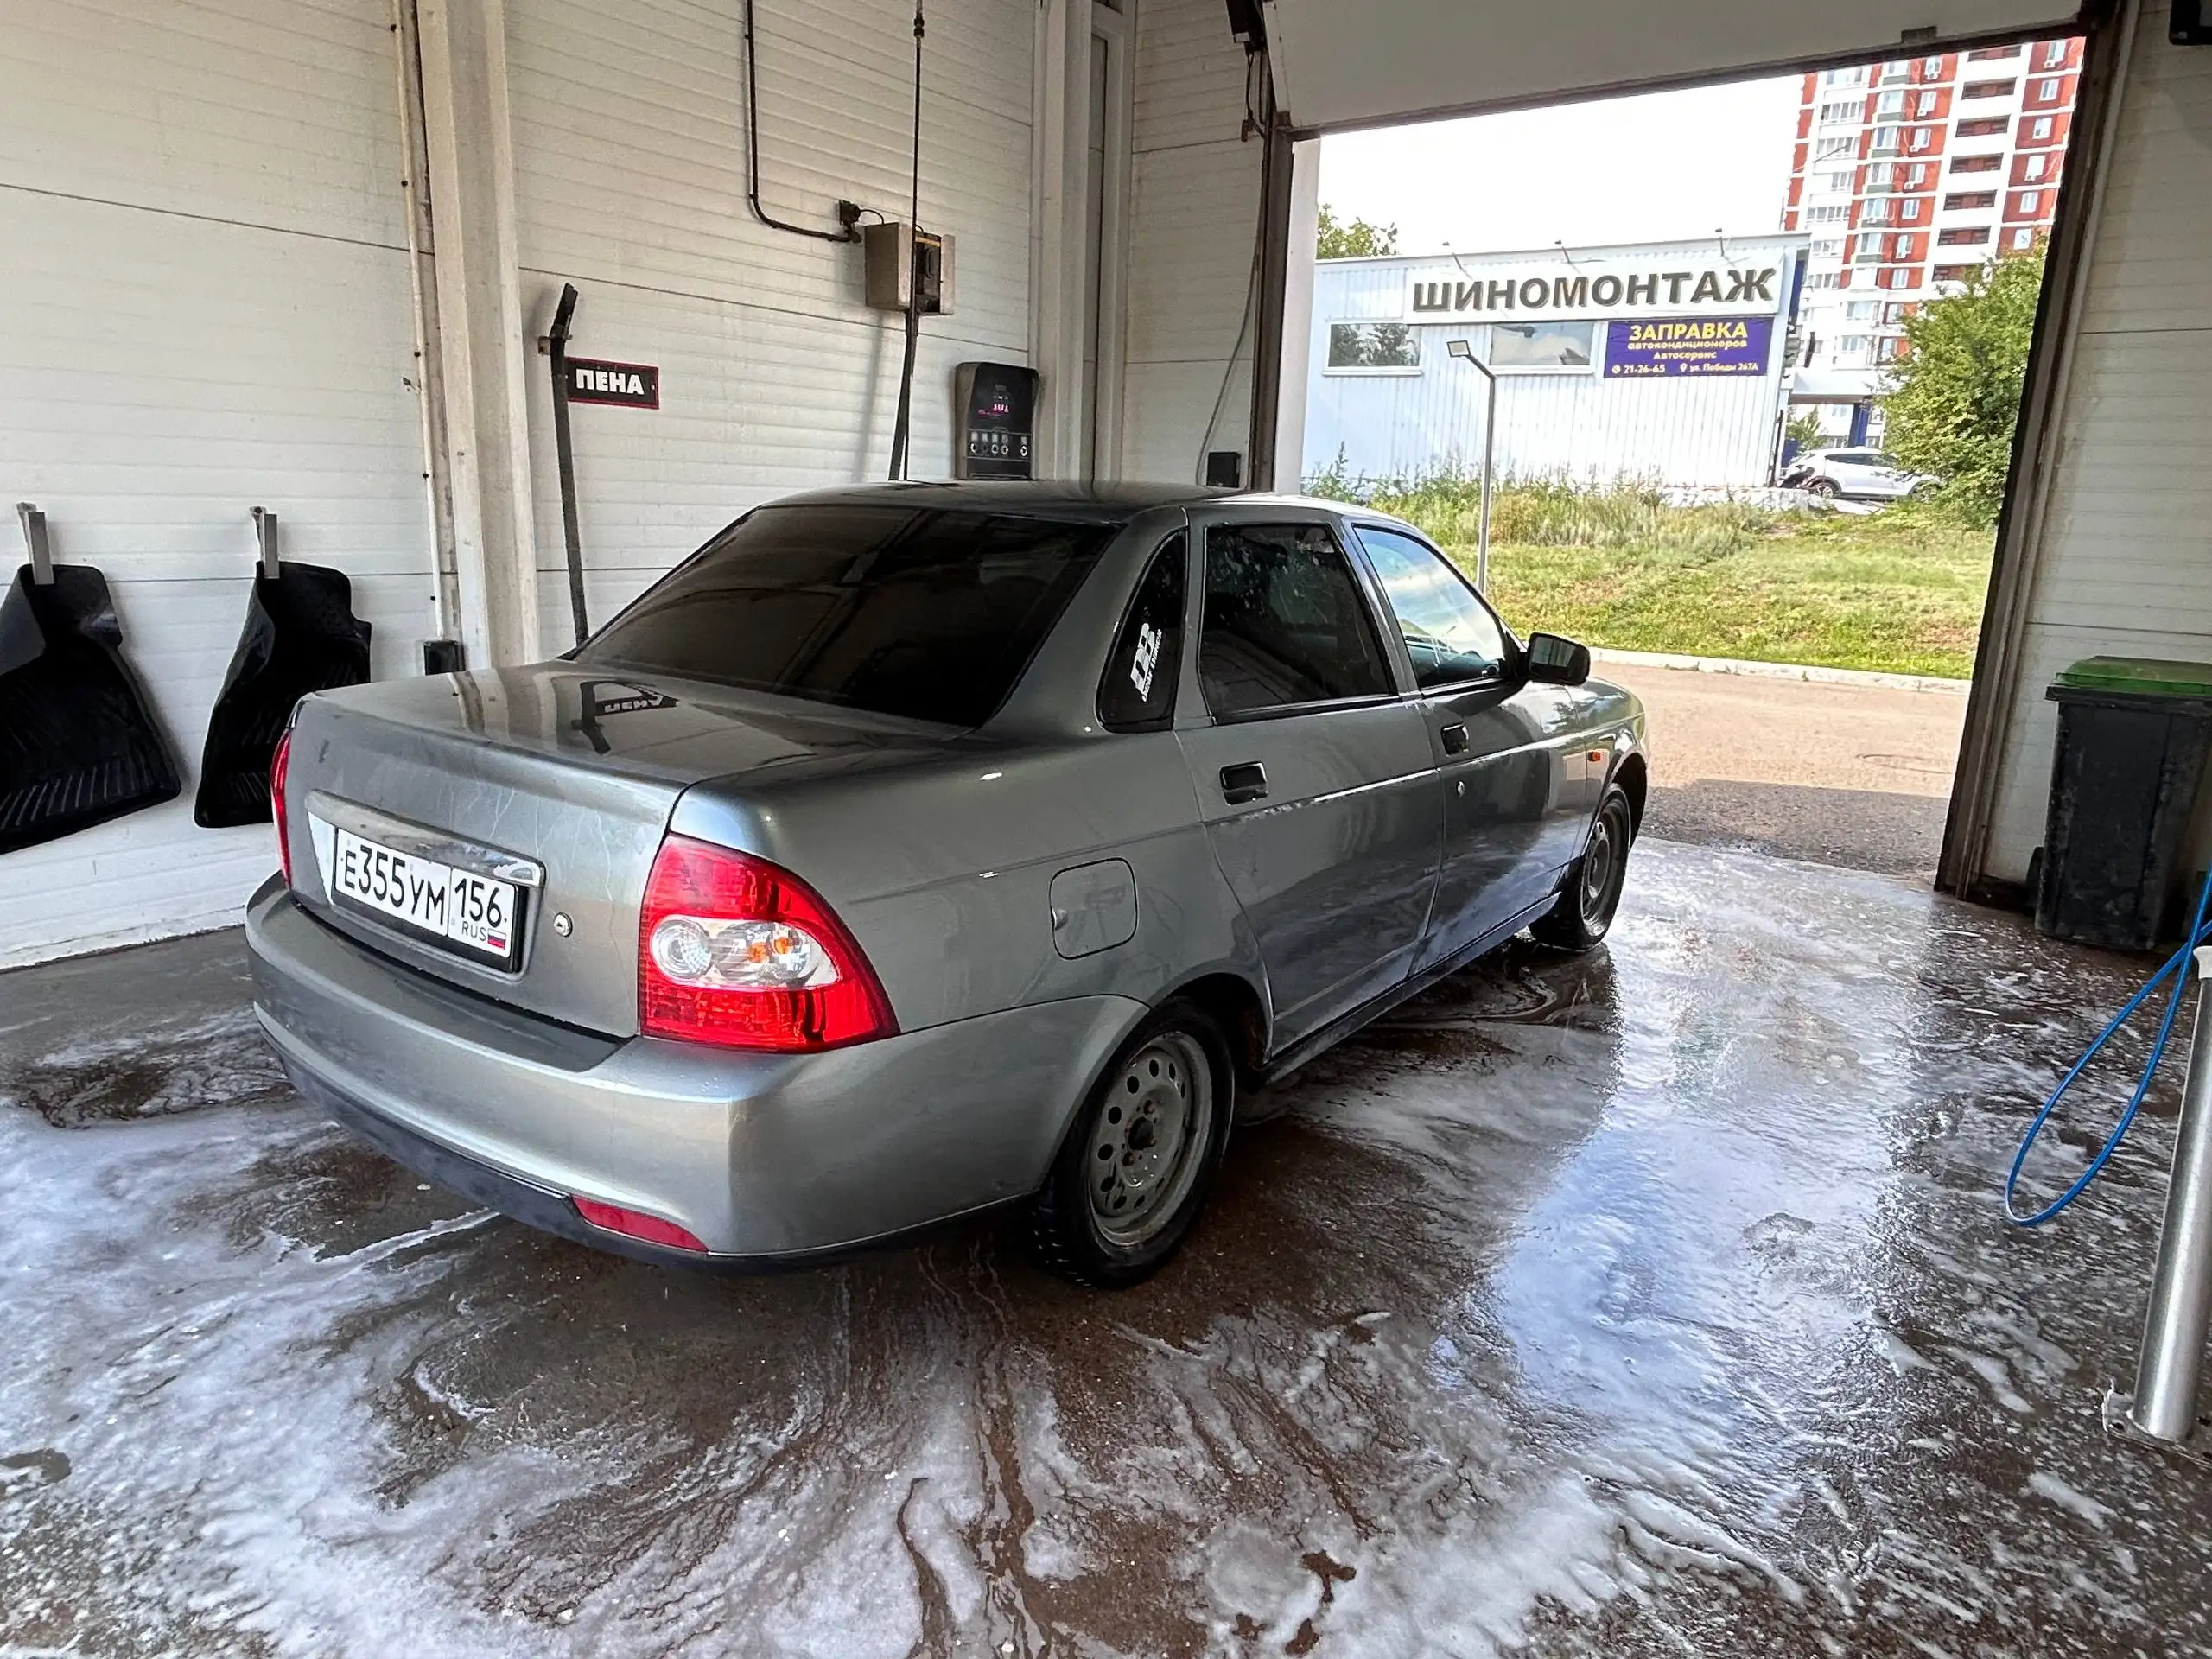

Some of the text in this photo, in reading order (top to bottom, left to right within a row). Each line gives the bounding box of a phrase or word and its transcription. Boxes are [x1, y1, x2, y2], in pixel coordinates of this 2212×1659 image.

[1412, 266, 1777, 312] ШИНОМОНТАЖ
[1629, 321, 1749, 340] ЗАПРАВКА
[1627, 340, 1748, 351] автокондиционеров
[1653, 352, 1718, 361] Автосервис
[1624, 364, 1666, 374] 21-26-65
[575, 368, 645, 395] ПЕНА
[344, 844, 502, 928] Е355УМ 156
[461, 920, 486, 942] RUS
